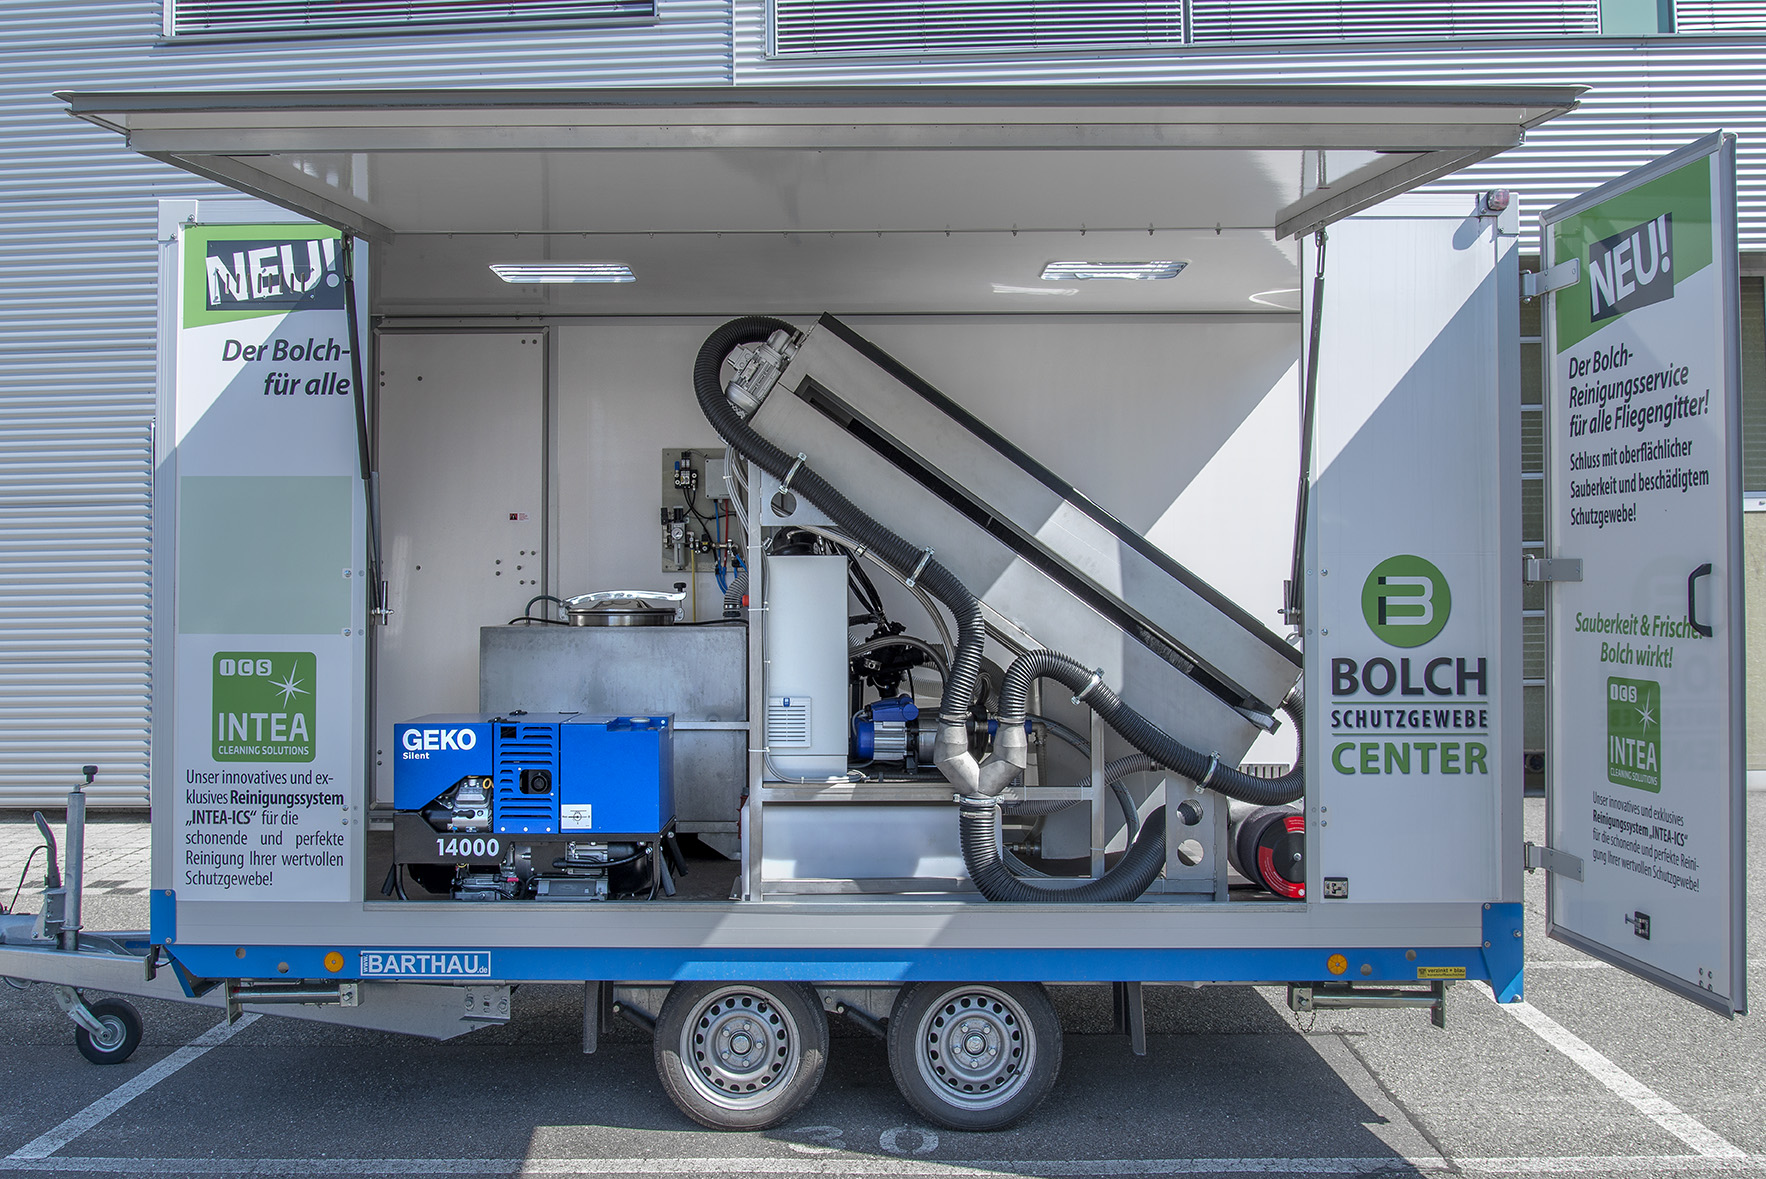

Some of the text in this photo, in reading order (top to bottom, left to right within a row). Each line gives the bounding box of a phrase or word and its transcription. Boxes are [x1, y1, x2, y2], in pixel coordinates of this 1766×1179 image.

[206, 238, 339, 305] NEU!
[1589, 214, 1670, 316] NEU!
[222, 338, 350, 361] Der Bolch-
[1569, 343, 1633, 379] Der Bolch-
[264, 372, 350, 395] für alle
[1569, 363, 1689, 408] Reinigungsservice
[1570, 389, 1709, 437] für alle Fliegengitter!
[1570, 437, 1692, 471] Schluss mit oberflächlicher
[1571, 468, 1709, 498] Sauberkeit und beschädigtem
[1571, 503, 1636, 529] Schutzgewebe!
[1575, 612, 1638, 635] Sauberkeit
[1640, 615, 1650, 636] &
[1601, 642, 1673, 668] Bolch wirkt!
[221, 660, 271, 675] ICS
[1331, 657, 1487, 695] BOLCH
[1611, 684, 1636, 702] ICS
[219, 713, 309, 741] INTEA
[1331, 710, 1488, 728] SCHUTZGEWEBE
[218, 746, 309, 755] CLEANING SOLUTIONS
[402, 729, 476, 751] GEKO
[403, 752, 430, 760] Silent
[1332, 742, 1488, 774] CENTER
[1610, 736, 1657, 772] INTEA
[186, 769, 333, 784] Unser innovatives und ex-
[1611, 768, 1657, 785] CLEANING SOLUTIONS
[186, 789, 344, 808] klusives Reinigungssystem
[1593, 791, 1684, 826] Unser innovatives und exklusives
[186, 810, 299, 826] „INTEA-ICS“ für die
[1593, 810, 1648, 835] Reinigungssystem
[186, 830, 344, 849] schonende und perfekte
[436, 838, 499, 856] 14000
[1601, 830, 1610, 844] die
[1611, 833, 1640, 854] schonende
[1641, 845, 1653, 857] und
[1654, 848, 1679, 866] perfekte
[1681, 853, 1699, 871] Reini-
[186, 850, 343, 868] Reinigung Ihrer wertvollen
[1593, 849, 1699, 892] gung Ihrer wertvollen Schutzgewebe!
[186, 871, 273, 889] Schutzgewebe!
